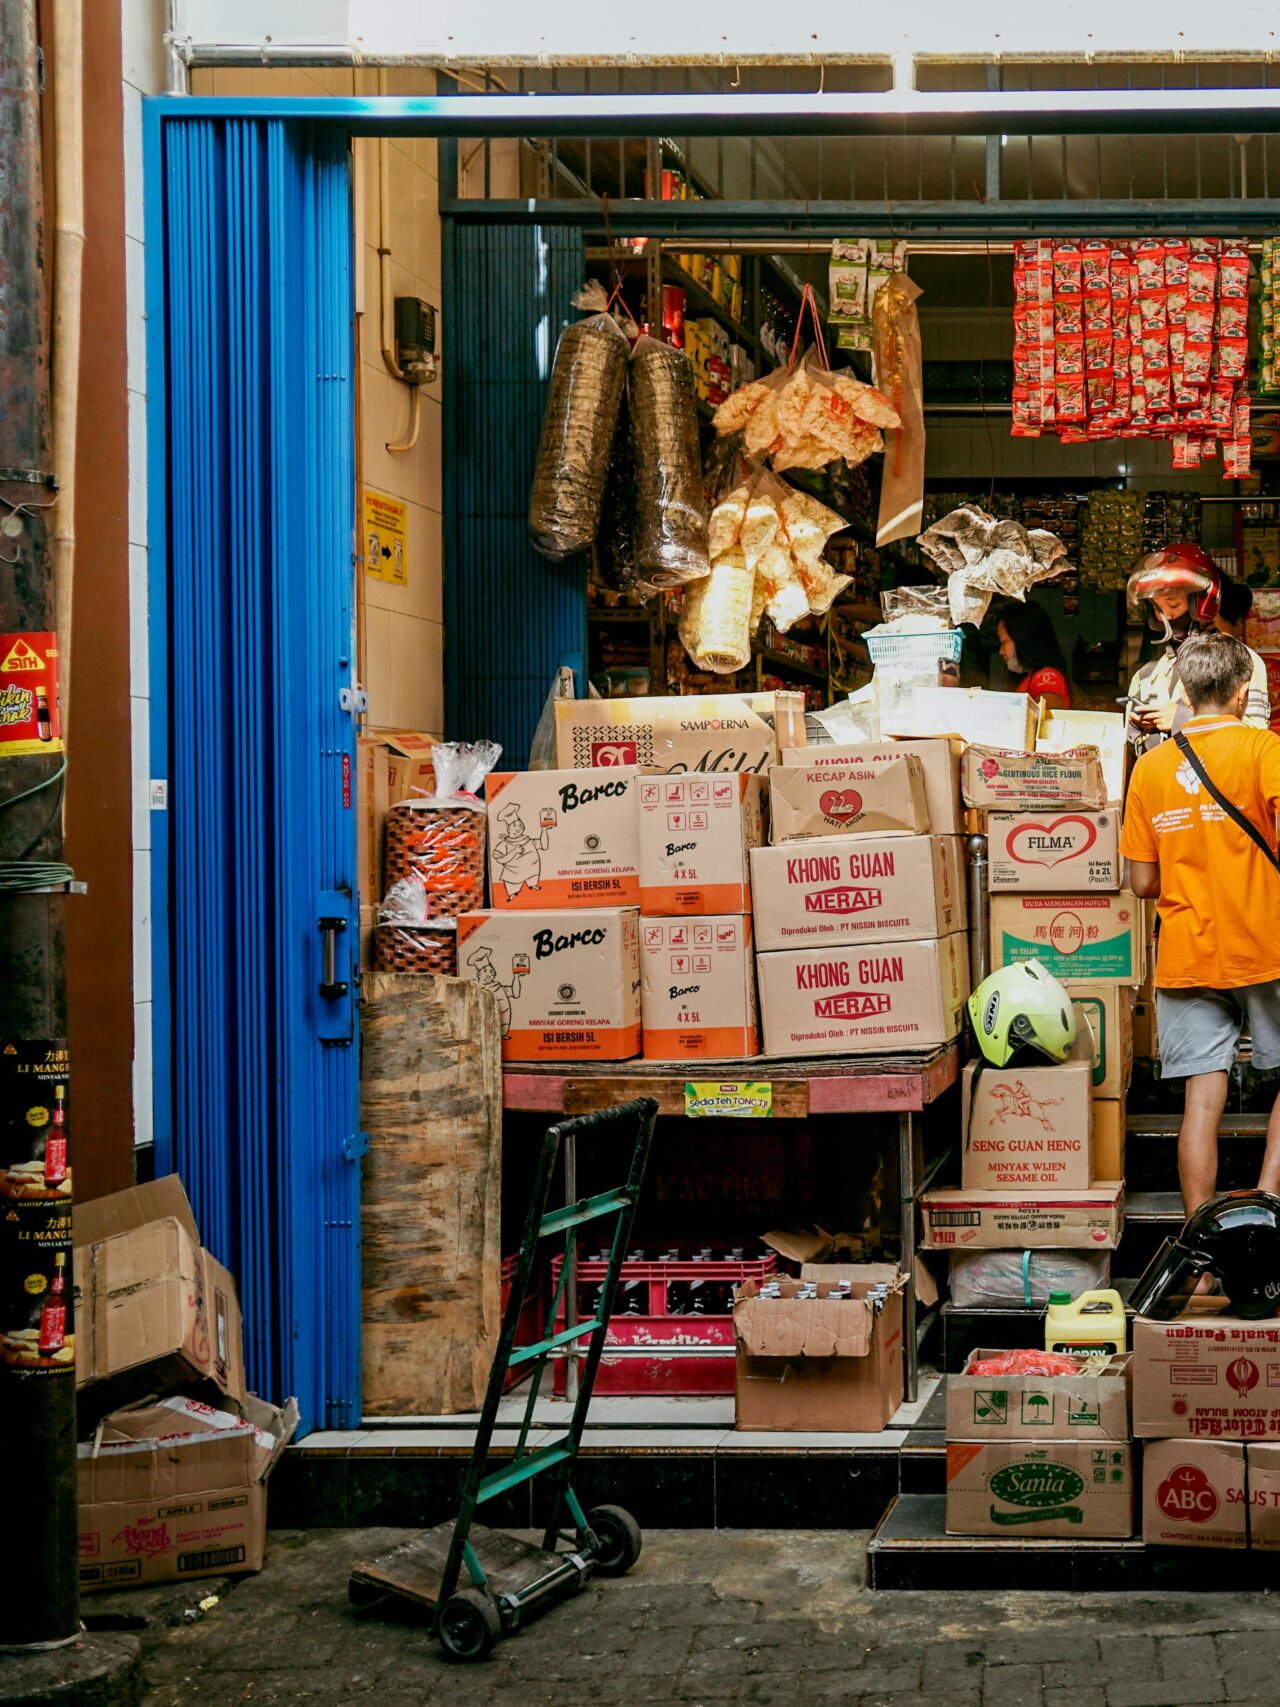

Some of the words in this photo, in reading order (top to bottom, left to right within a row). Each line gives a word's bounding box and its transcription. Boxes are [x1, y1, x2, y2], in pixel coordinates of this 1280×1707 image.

[806, 772, 846, 783] KECAP
[848, 771, 875, 781] ASIN
[1003, 769, 1040, 779] GLUTINOUS
[1042, 769, 1058, 778] RICE
[1059, 769, 1082, 779] FLOUR
[558, 780, 628, 813] Barco
[823, 816, 842, 829] HATI
[845, 812, 866, 829] ANGSA
[1028, 836, 1073, 849] FILMA
[665, 842, 697, 857] Barco
[558, 867, 583, 876] MINYAK
[584, 867, 610, 875] GORENG
[611, 866, 635, 874] KELAPA
[786, 855, 841, 884] KHONG
[849, 851, 895, 879] GUAN
[673, 869, 679, 880] 4
[681, 869, 687, 879] X
[688, 869, 698, 879] 5L
[571, 881, 582, 891] ISI
[583, 879, 611, 891] BERSIH
[612, 879, 621, 889] 5L
[804, 889, 882, 911] MERAH
[781, 925, 818, 936] Diproduksi
[818, 924, 834, 933] Oleh
[851, 921, 876, 930] NISSIN
[877, 919, 910, 929] BISCUITS
[533, 927, 606, 961] Barco
[796, 961, 849, 989] KHONG
[858, 957, 904, 985] GUAN
[669, 985, 700, 1000] Barco
[814, 995, 891, 1017] MERAH
[677, 1012, 683, 1023] 4
[684, 1012, 690, 1023] X
[691, 1011, 701, 1023] 5L
[986, 996, 998, 1031] INK
[528, 1019, 555, 1027] MINYAK
[585, 1018, 610, 1026] KELAPA
[543, 1033, 555, 1043] ISI
[556, 1032, 584, 1043] BERSIH
[586, 1032, 596, 1042] 5L
[790, 1031, 827, 1042] Diproduksi
[828, 1030, 844, 1038] Oleh
[849, 1028, 858, 1036] PT
[860, 1027, 885, 1035] NISSIN
[887, 1024, 919, 1034] BISCUITS
[17, 1064, 29, 1073] LI
[689, 1097, 714, 1108] sedia
[715, 1097, 732, 1105] Teh
[733, 1097, 756, 1106] TONG
[758, 1099, 768, 1108] TJI
[972, 1140, 1005, 1152] SENG
[1008, 1140, 1044, 1152] GUAN
[1047, 1140, 1082, 1152] HENG
[988, 1162, 1030, 1171] MINYAK
[1033, 1162, 1066, 1171] WIJEN
[996, 1173, 1038, 1182] SESAME
[1040, 1173, 1058, 1182] OIL
[18, 1230, 30, 1240] LI
[1165, 1327, 1226, 1343] Pangan
[1195, 1407, 1229, 1417] BULAN
[1232, 1408, 1268, 1417] ATOOM
[1223, 1418, 1267, 1437] Telor
[1007, 1471, 1065, 1493] Sania
[1162, 1487, 1213, 1512] ABC
[1226, 1487, 1267, 1506] SAUS
[166, 1505, 194, 1516] APPLE
